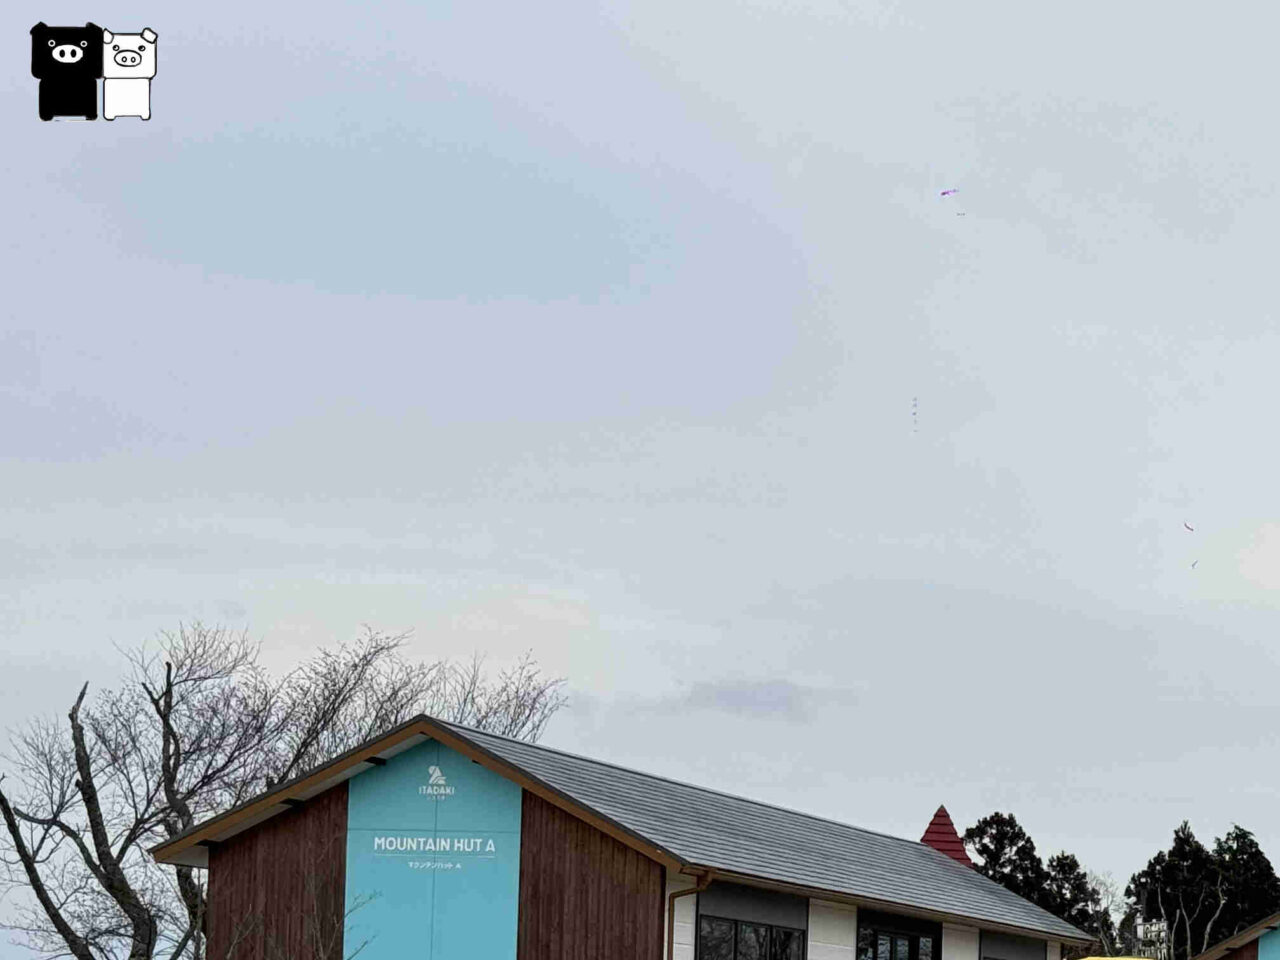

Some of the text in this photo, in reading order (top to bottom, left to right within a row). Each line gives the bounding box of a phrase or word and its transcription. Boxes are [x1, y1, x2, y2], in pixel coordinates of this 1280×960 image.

[418, 786, 455, 795] ITADAKI
[373, 836, 496, 852] MOUNTAIN HUT A
